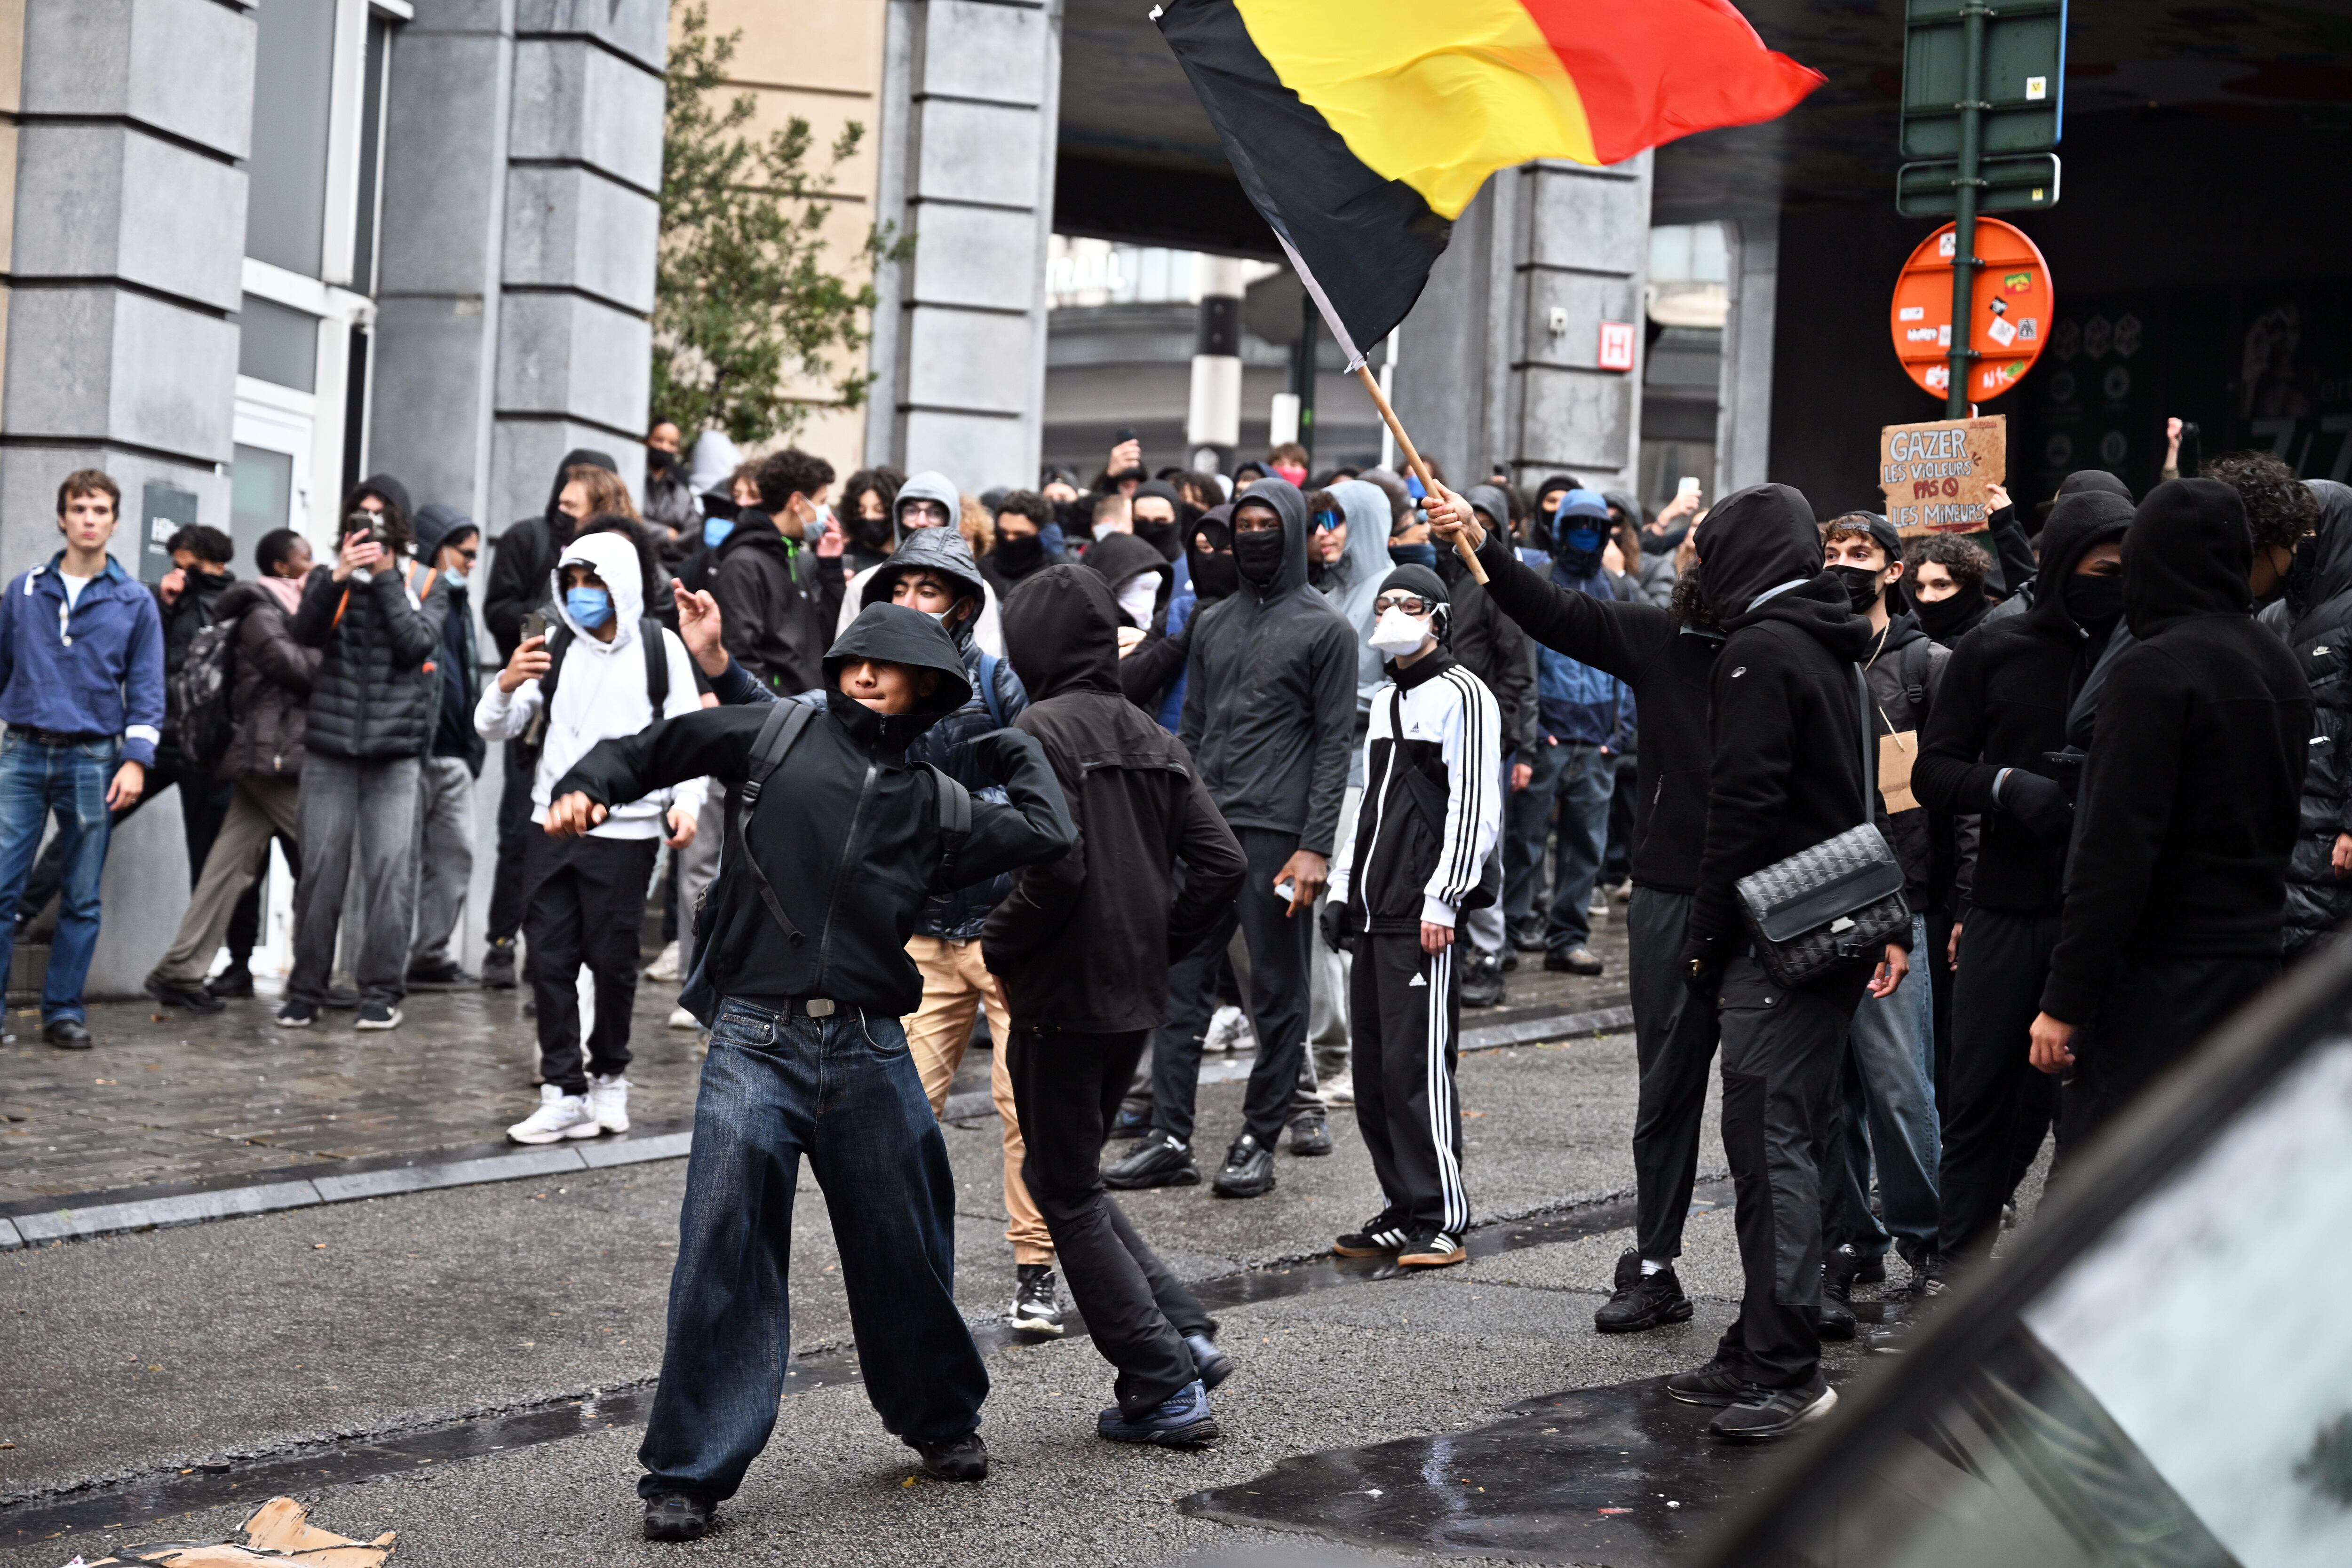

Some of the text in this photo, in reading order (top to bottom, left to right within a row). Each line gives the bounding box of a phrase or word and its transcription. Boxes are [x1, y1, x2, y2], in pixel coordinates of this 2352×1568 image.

[1608, 331, 1626, 359] H
[1890, 428, 1968, 462] GAZER
[1884, 464, 1906, 483] LES
[1913, 480, 1939, 499] PAS
[1892, 505, 1919, 528] LES
